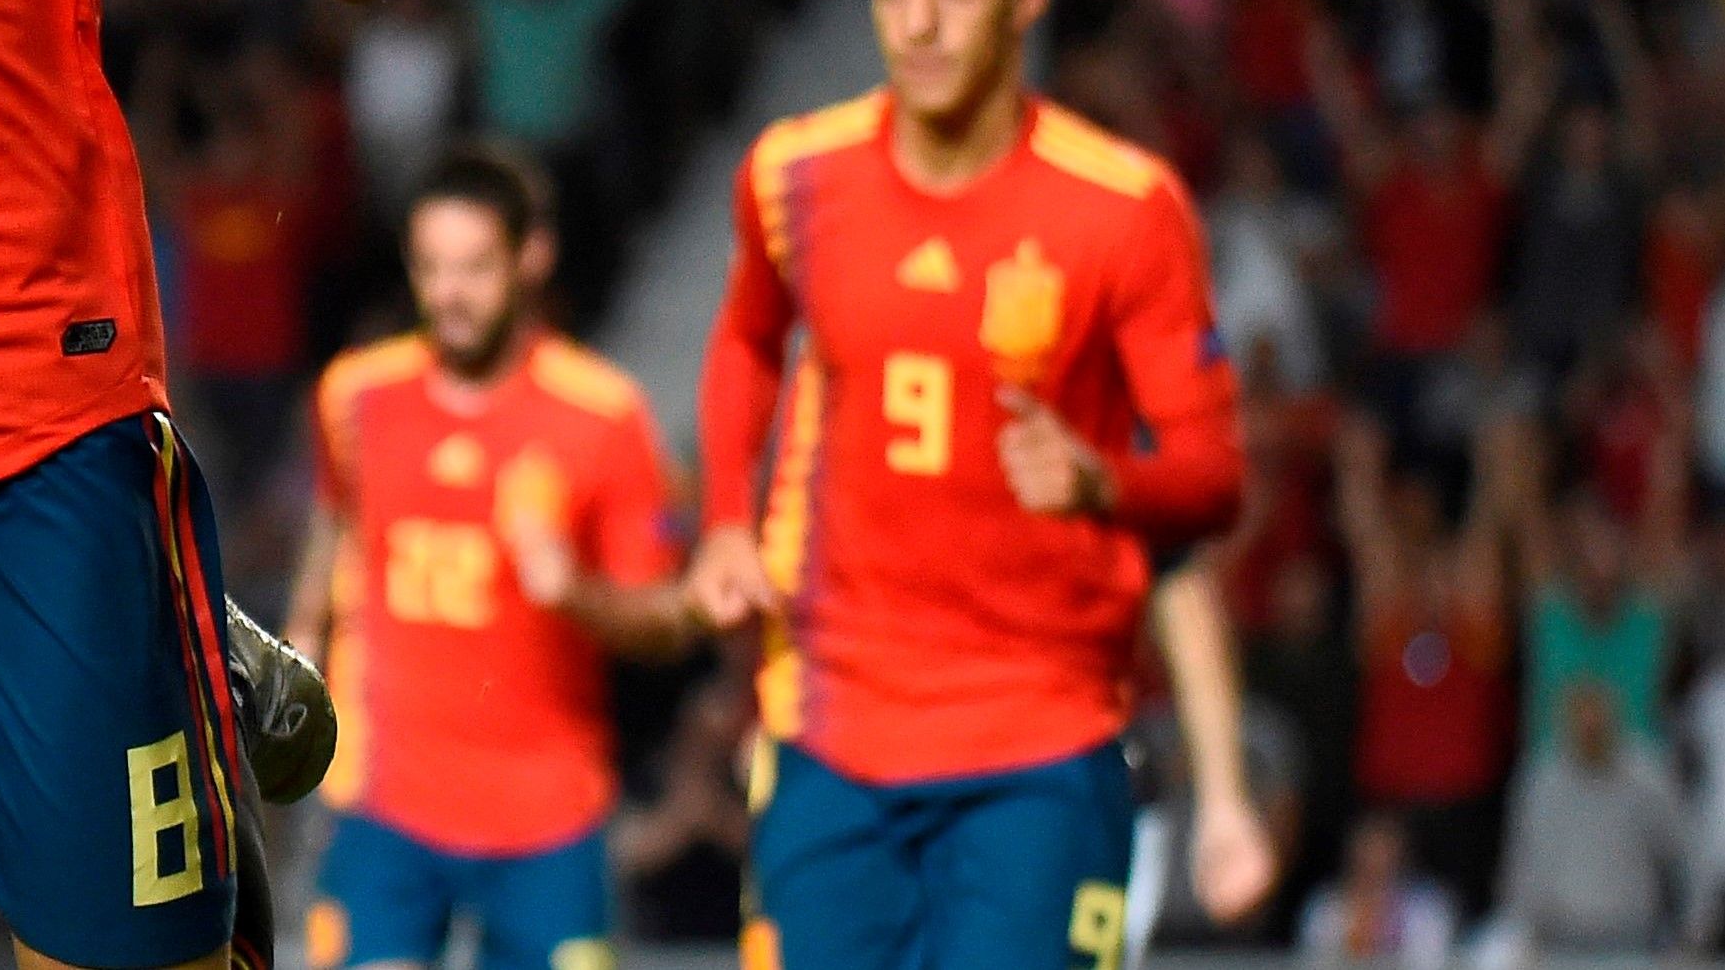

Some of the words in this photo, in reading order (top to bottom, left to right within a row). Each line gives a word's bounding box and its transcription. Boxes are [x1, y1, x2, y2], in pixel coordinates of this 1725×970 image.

[883, 351, 952, 473] 9
[385, 516, 495, 628] 22
[127, 730, 204, 908] 8
